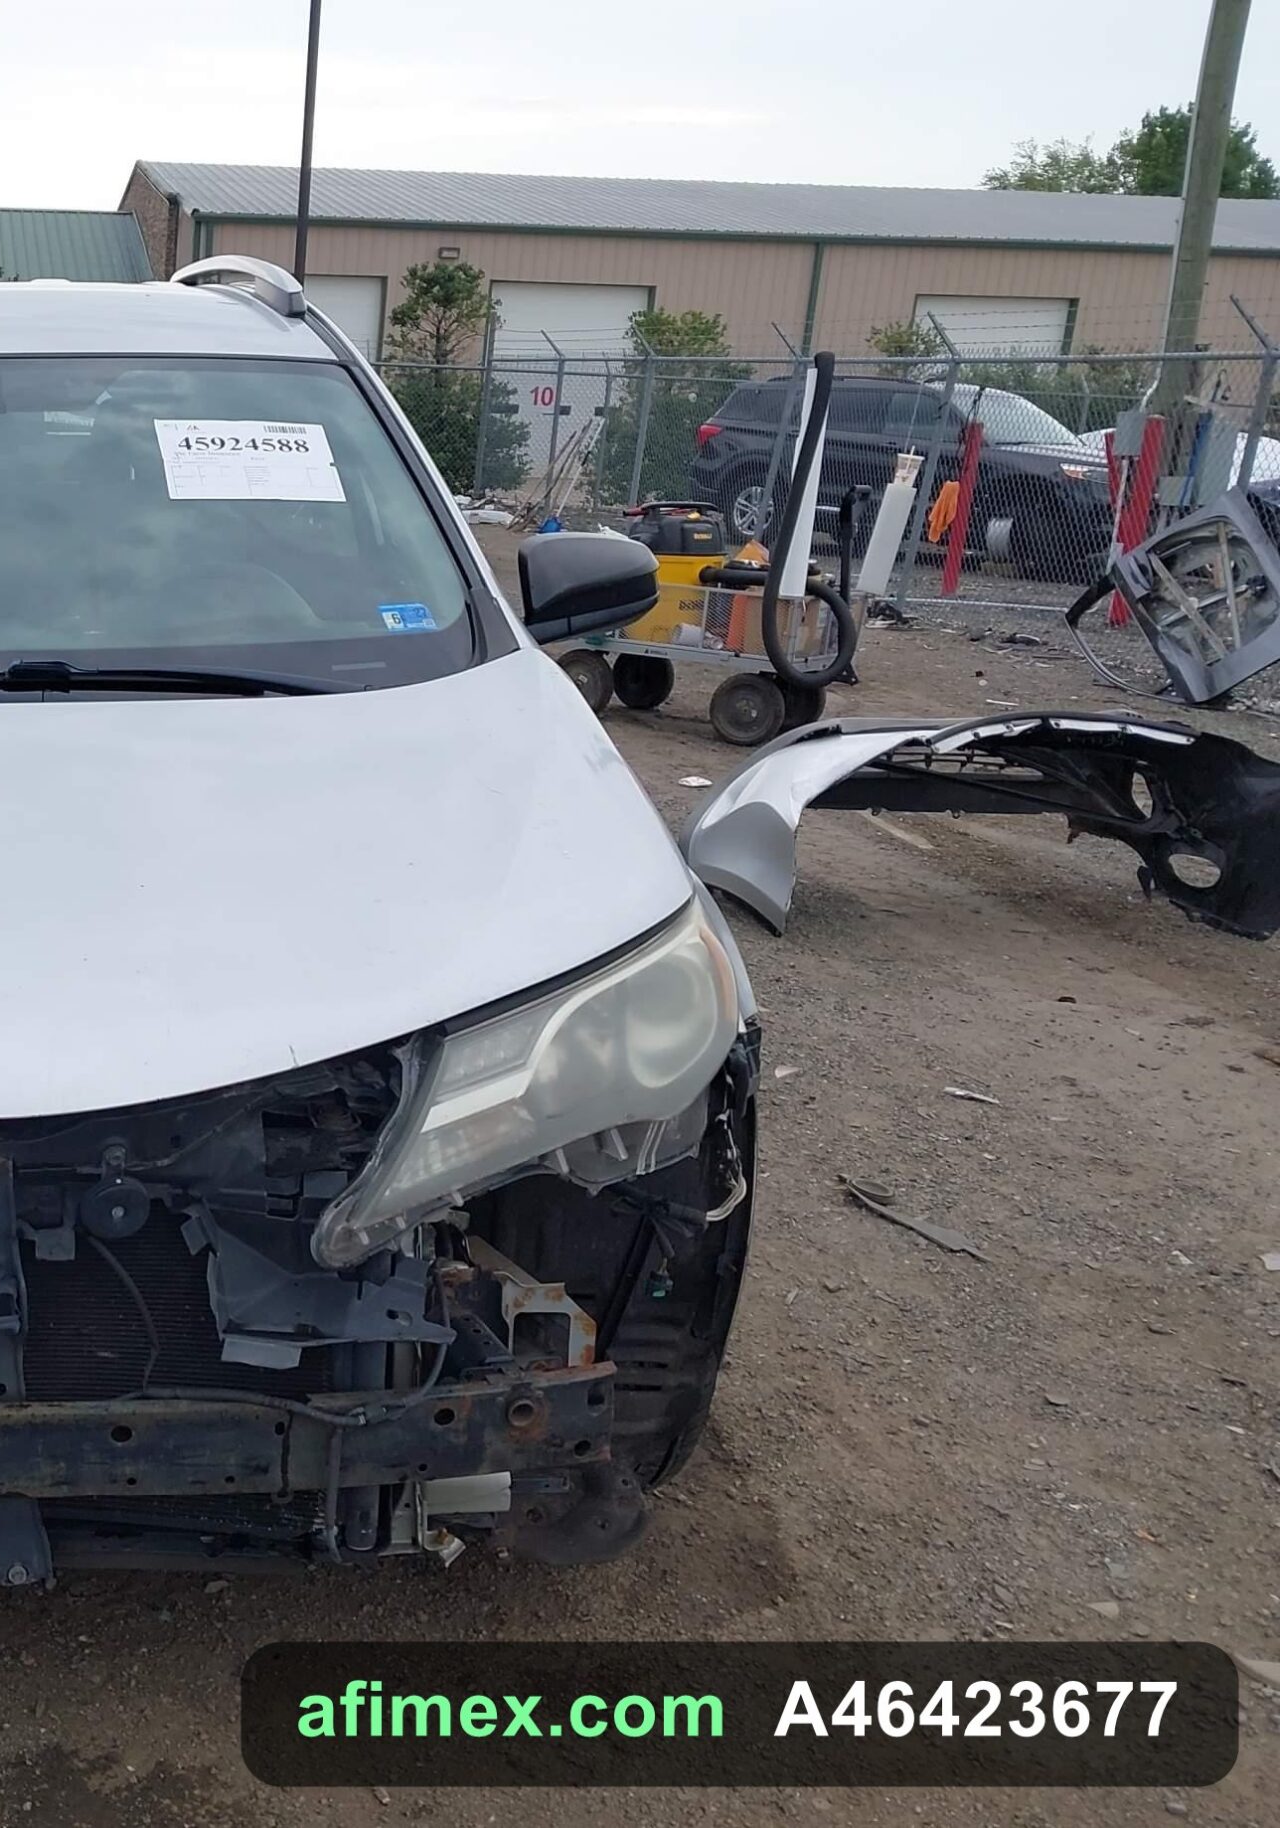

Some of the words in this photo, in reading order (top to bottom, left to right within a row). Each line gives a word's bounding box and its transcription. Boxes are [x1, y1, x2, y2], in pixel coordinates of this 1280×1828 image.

[529, 385, 554, 407] 10
[177, 436, 310, 453] 45924588
[391, 613, 401, 625] 6
